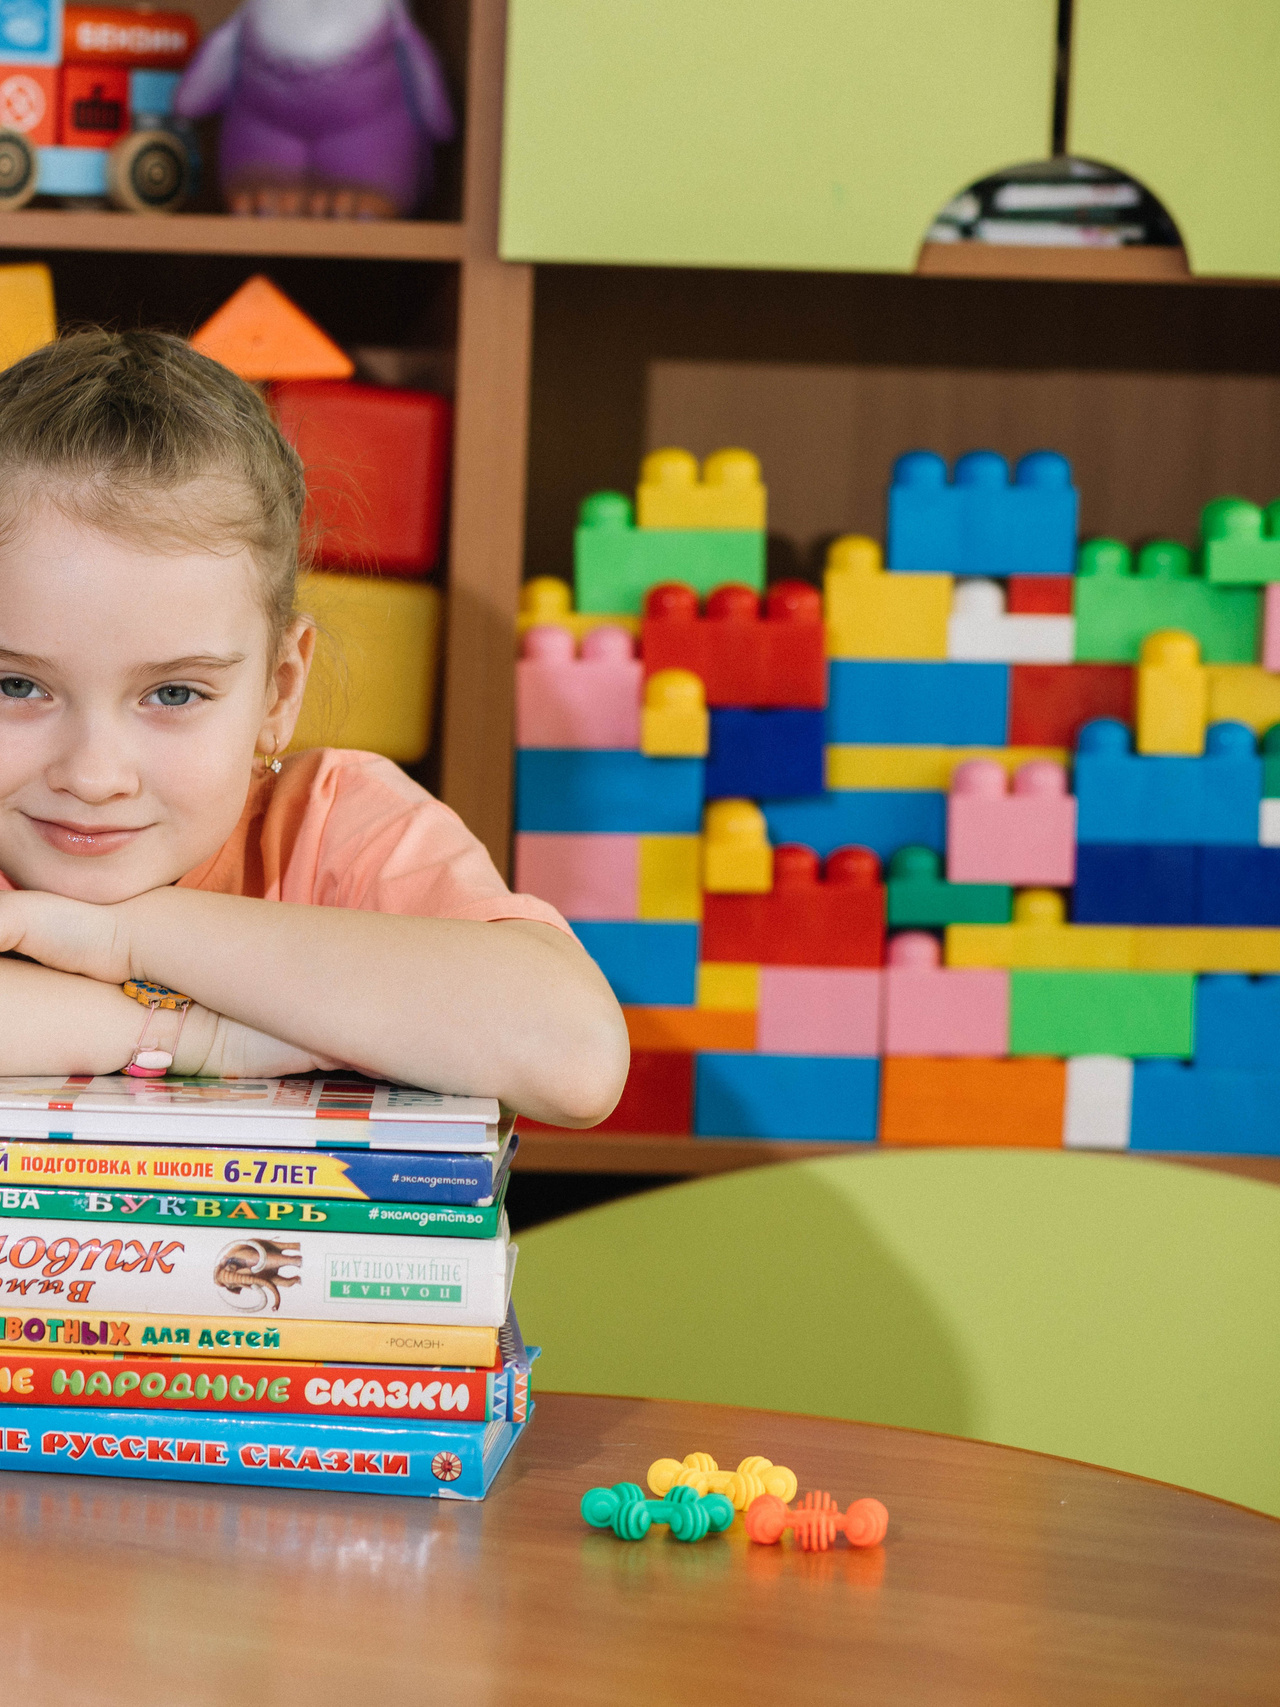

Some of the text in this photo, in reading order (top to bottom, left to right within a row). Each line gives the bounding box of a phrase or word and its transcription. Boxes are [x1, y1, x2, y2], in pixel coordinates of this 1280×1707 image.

[20, 1156, 132, 1175] ПОДГОТОВКА
[137, 1160, 148, 1176] К
[153, 1161, 214, 1178] ШКОЛЕ
[223, 1160, 268, 1184] 6-7
[270, 1164, 318, 1186] ЛЕТ
[391, 1173, 479, 1189] #эксмодетство
[85, 1193, 328, 1223] БУКВАРЬ
[368, 1207, 484, 1227] #эксмодетство
[330, 1259, 462, 1282] ЭНЦИКЛОПЕДИЯ
[342, 1283, 451, 1299] ПОЛНАЯ
[51, 1368, 292, 1404] НАРОДНЫЕ
[303, 1377, 471, 1413] СКАЗКИ
[41, 1430, 230, 1466] РУССКИЕ
[239, 1442, 411, 1478] СКАЗКИ
